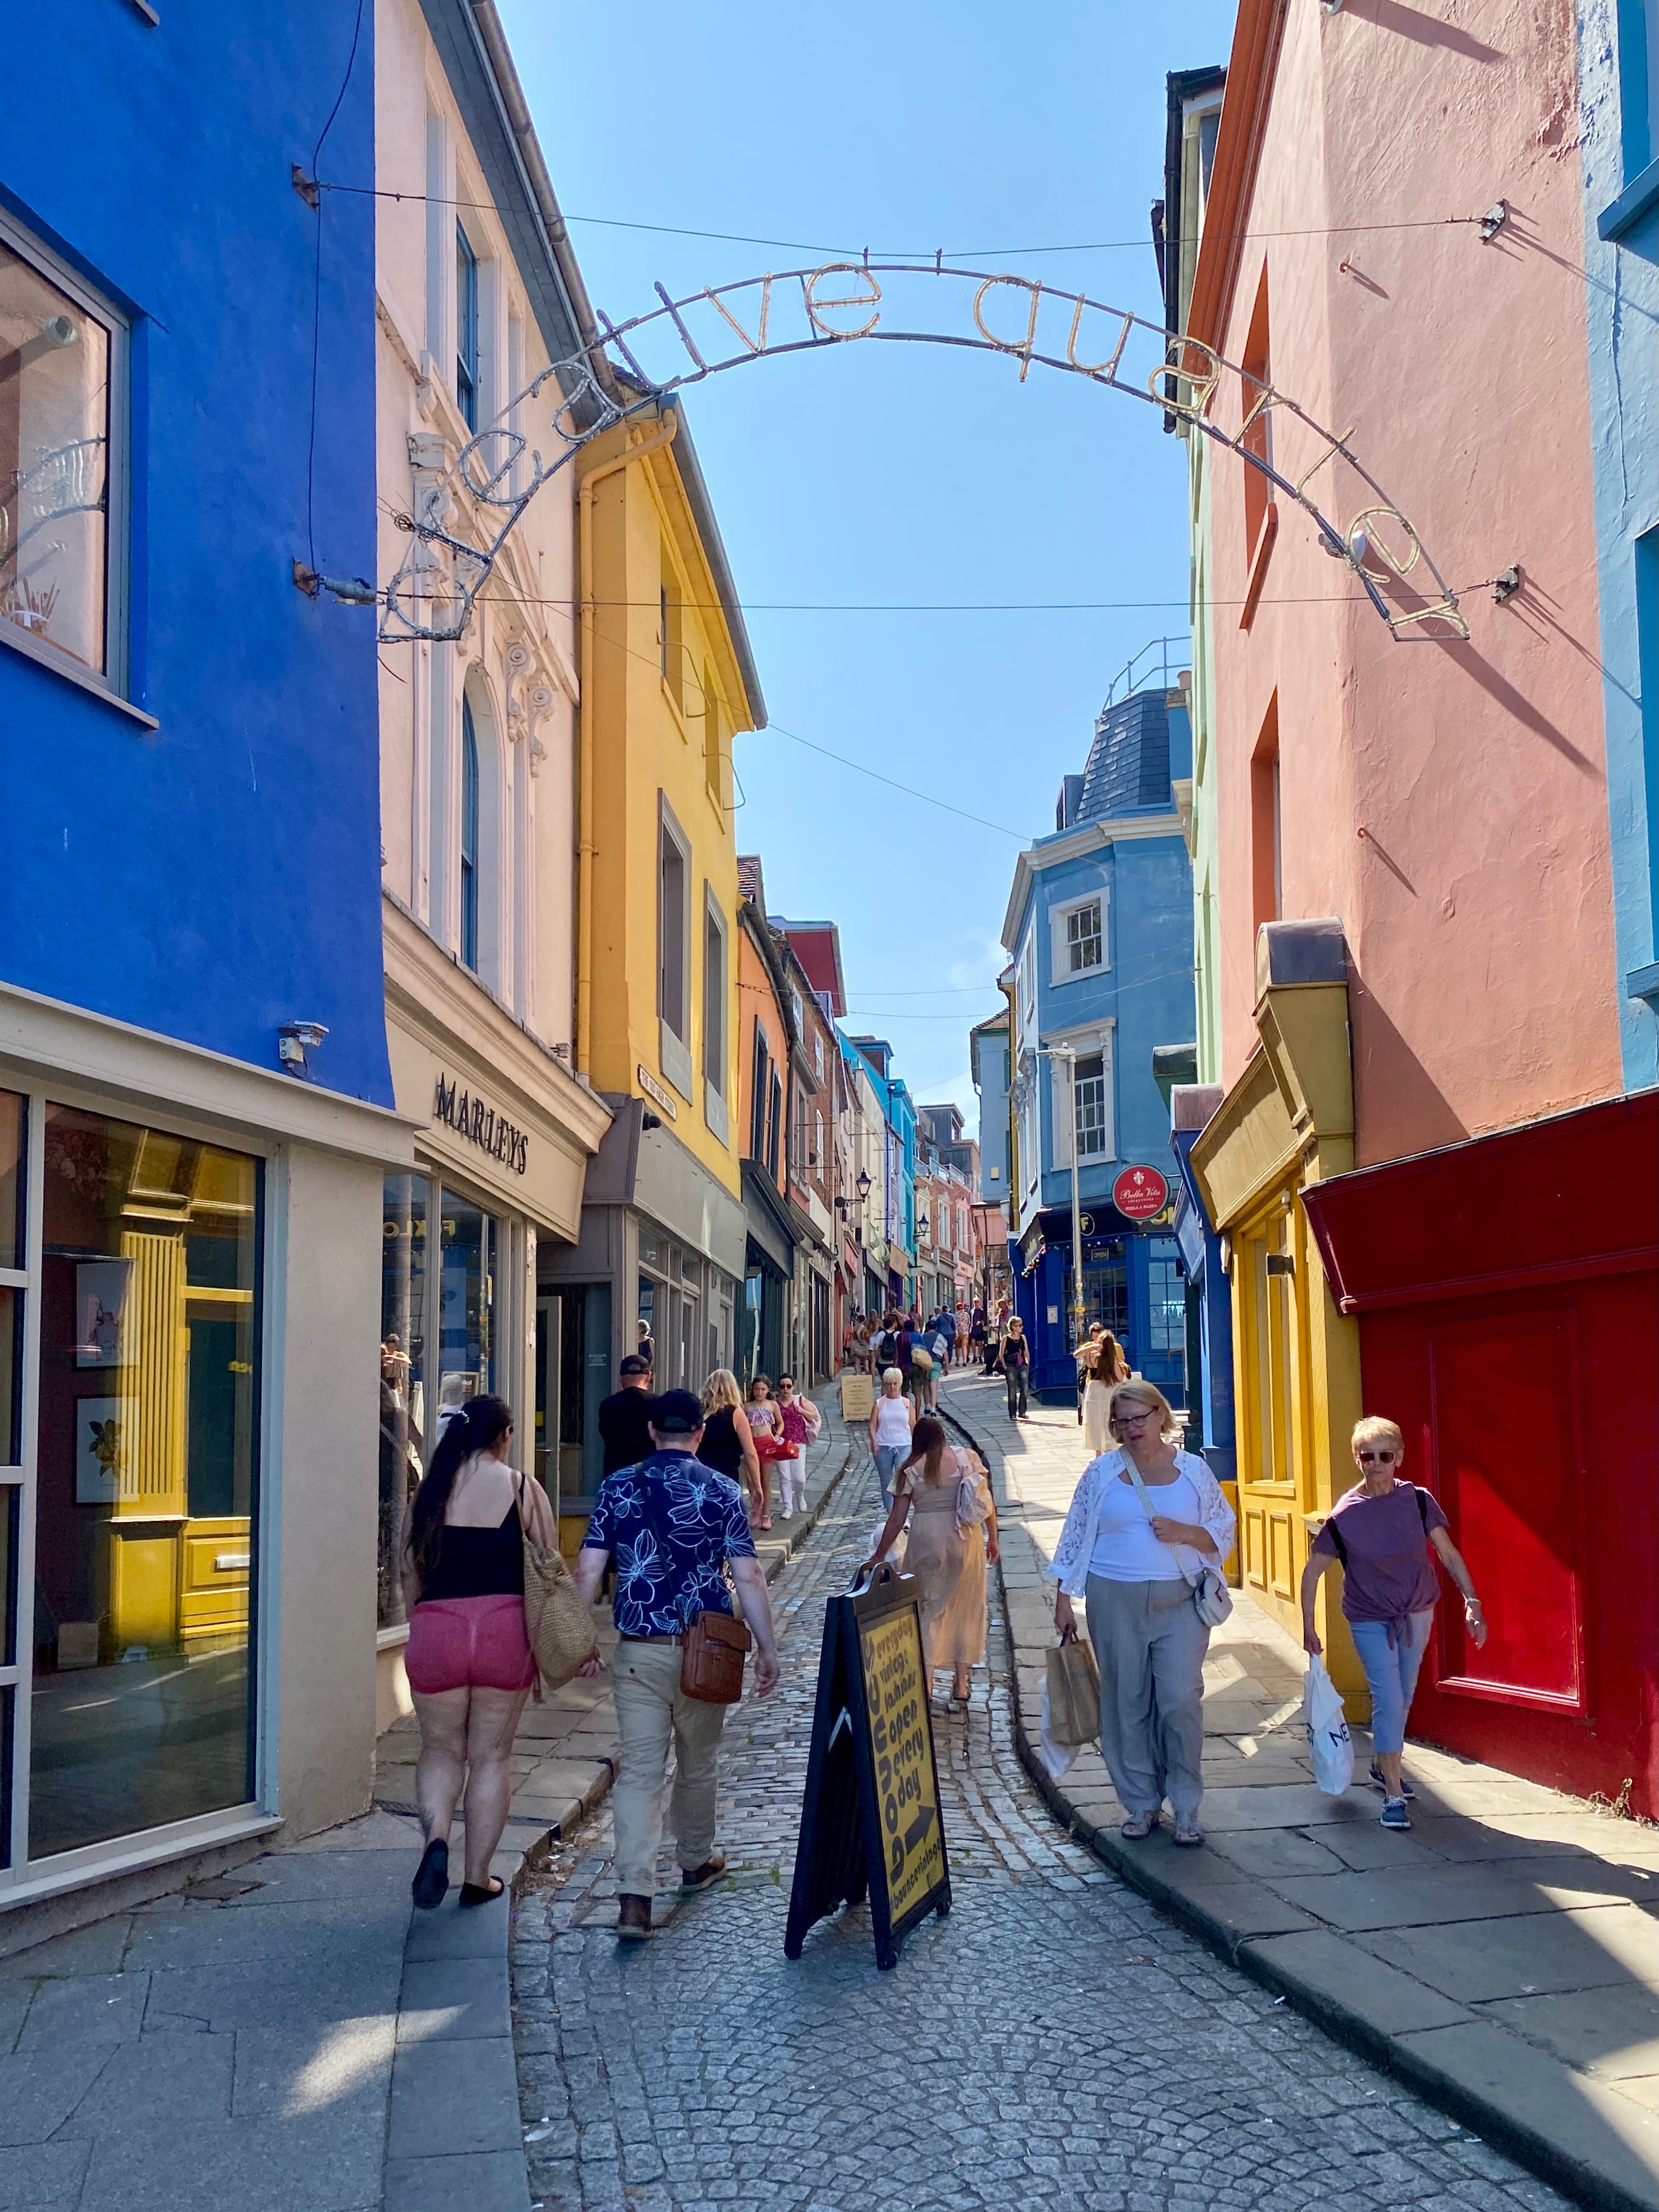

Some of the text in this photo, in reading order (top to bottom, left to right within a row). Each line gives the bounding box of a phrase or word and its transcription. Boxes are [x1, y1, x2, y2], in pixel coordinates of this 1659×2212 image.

[436, 1072, 529, 1175] MARLEYS
[1120, 1186, 1161, 1200] Bella Vita
[1081, 1216, 1089, 1232] F
[877, 1616, 913, 1660] everyday
[890, 1699, 918, 1745] open
[893, 1727, 924, 1776] every
[898, 1767, 921, 1808] day
